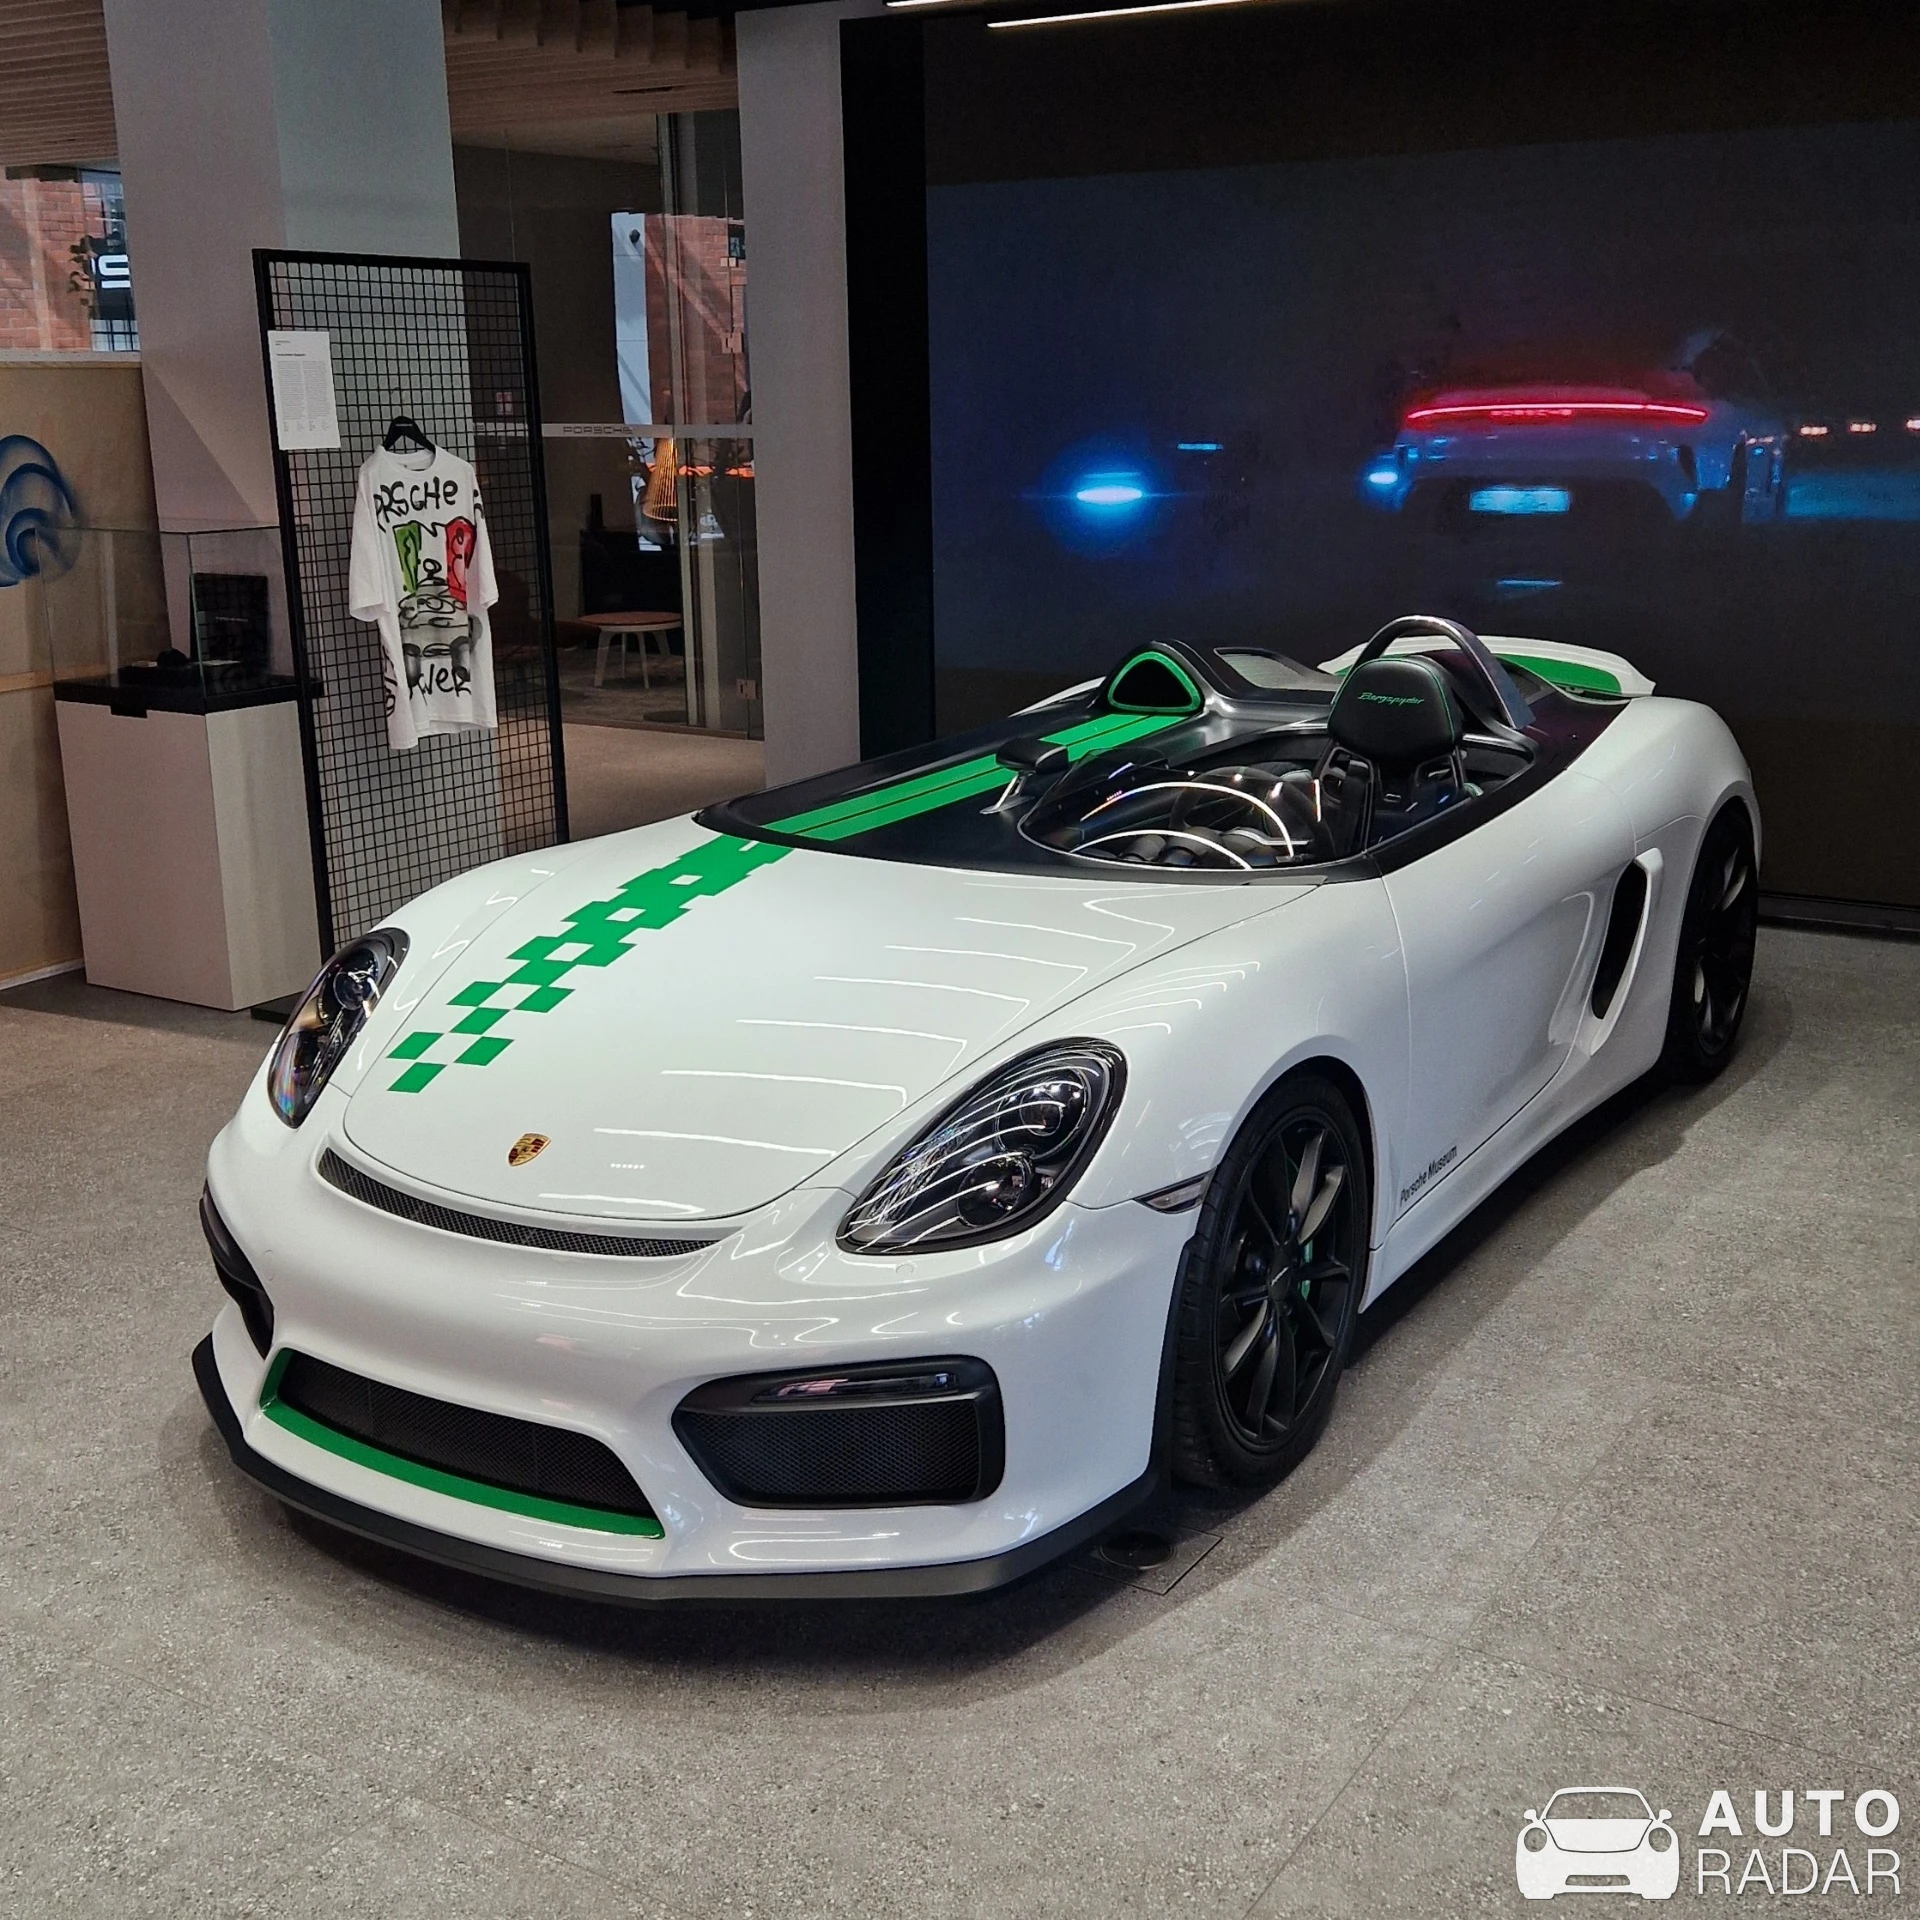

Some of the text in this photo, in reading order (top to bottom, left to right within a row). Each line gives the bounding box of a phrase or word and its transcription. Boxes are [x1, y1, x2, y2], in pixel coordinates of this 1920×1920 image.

[1358, 692, 1425, 706] Bergspyder
[1400, 1145, 1458, 1208] Porsche Museum
